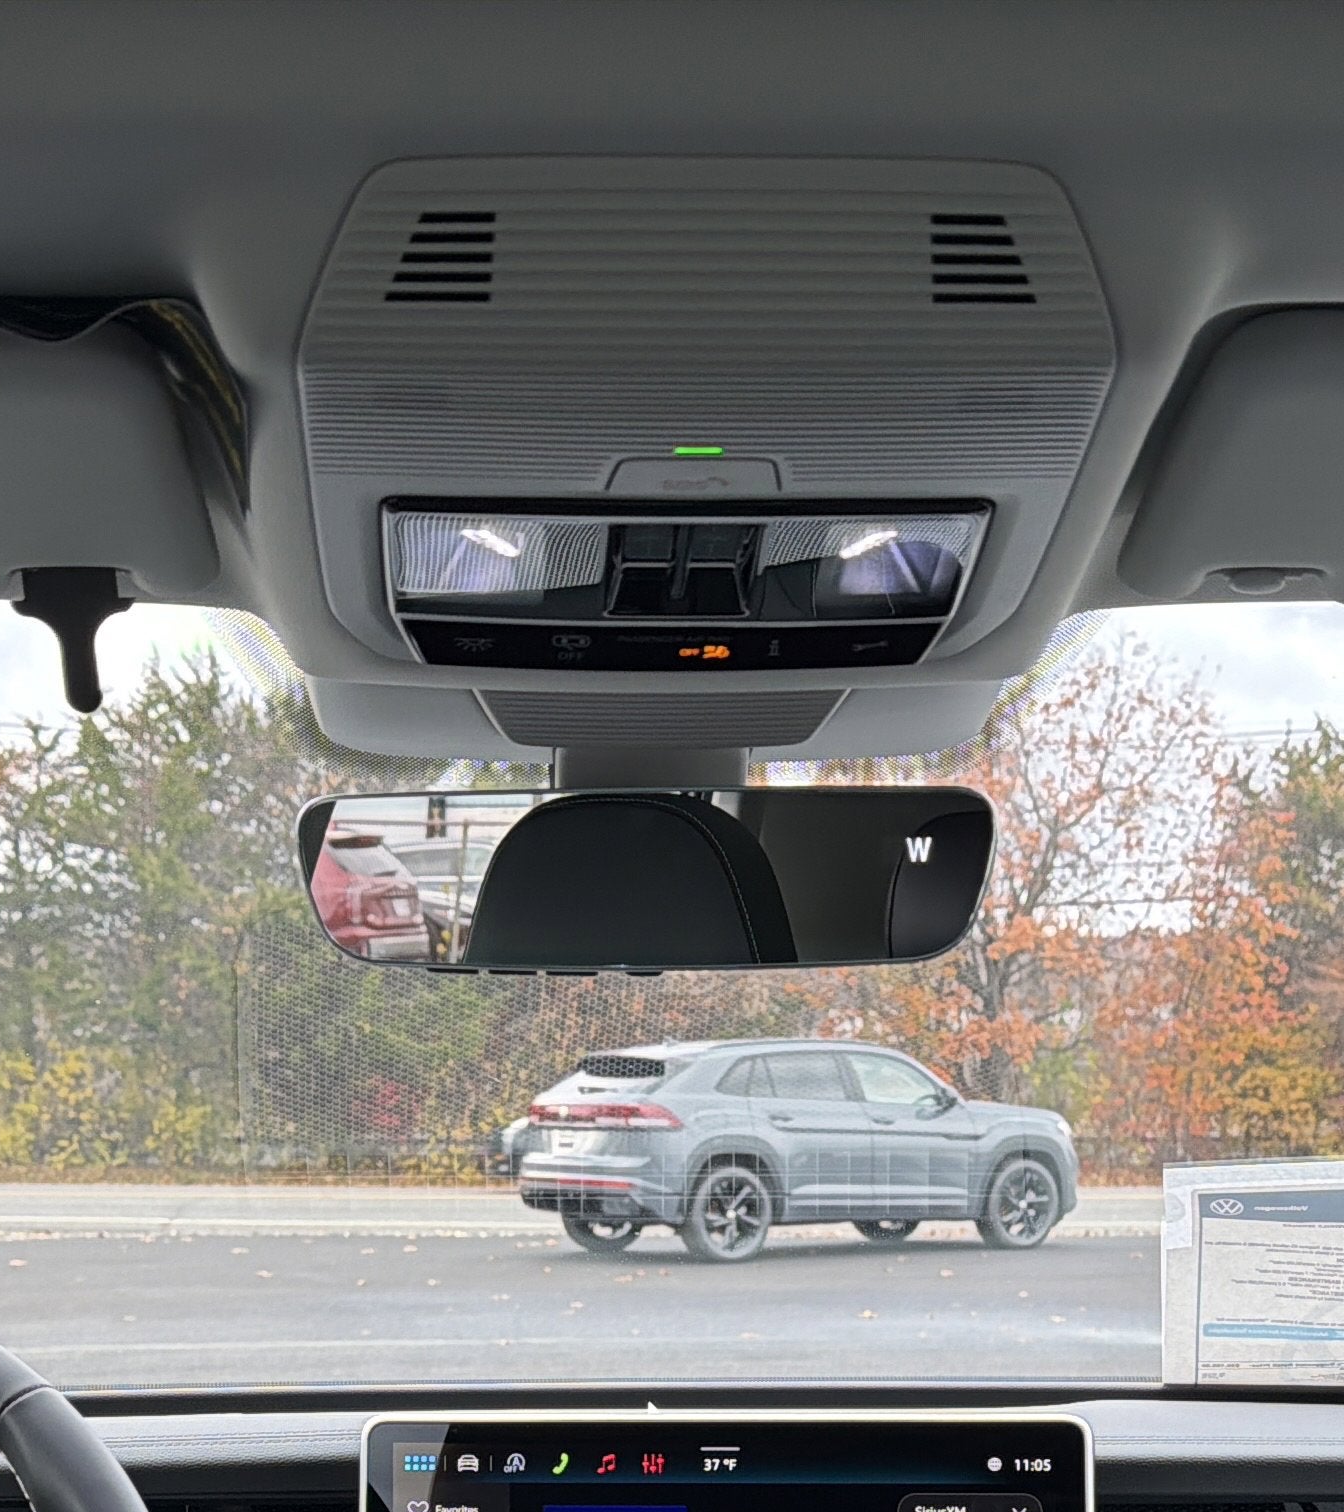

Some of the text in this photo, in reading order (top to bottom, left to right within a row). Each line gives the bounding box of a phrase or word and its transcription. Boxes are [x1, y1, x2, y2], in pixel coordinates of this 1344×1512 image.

[906, 837, 932, 862] W
[703, 1459, 720, 1471] 37
[1014, 1459, 1051, 1472] 11:05
